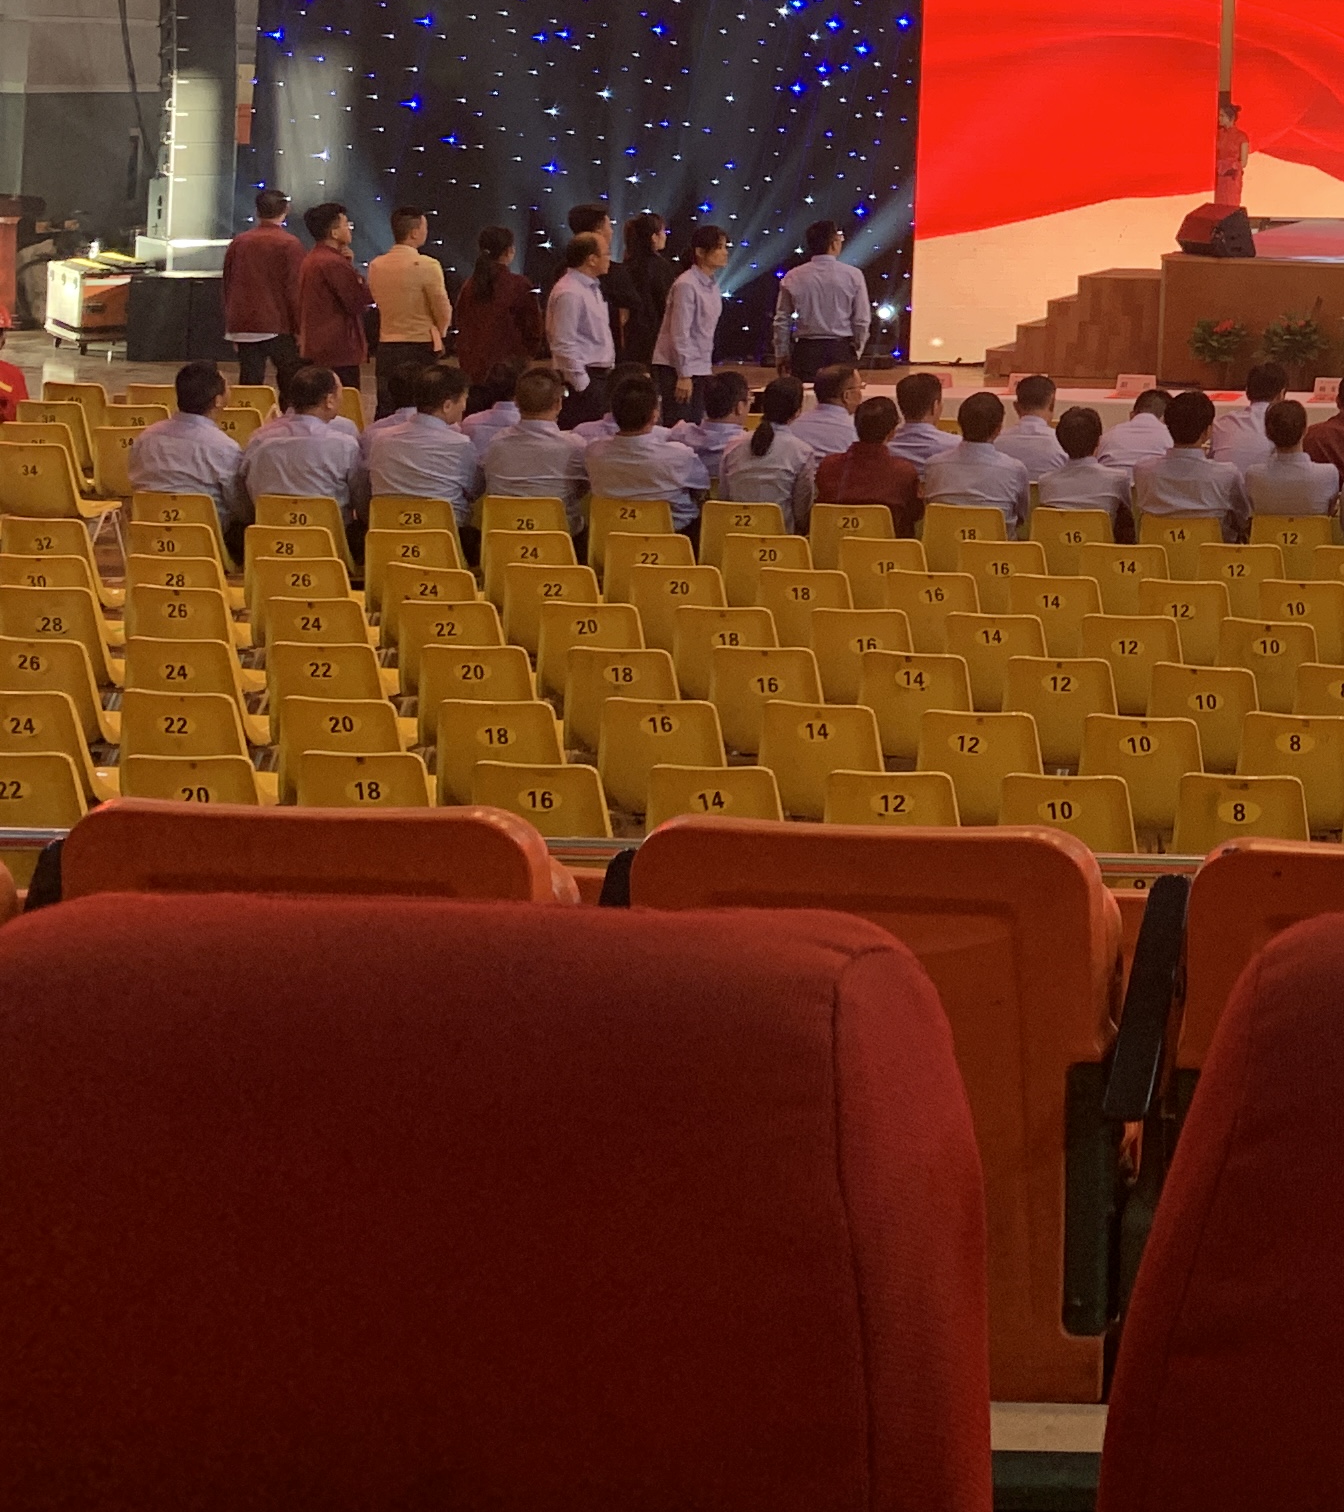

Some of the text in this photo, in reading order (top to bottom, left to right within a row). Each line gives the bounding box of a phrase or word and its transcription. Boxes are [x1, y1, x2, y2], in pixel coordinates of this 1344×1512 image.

[22, 465, 38, 475] 34
[404, 513, 422, 524] 28
[735, 515, 751, 527] 22
[960, 529, 976, 540] 18
[35, 537, 54, 551] 32
[157, 540, 175, 553] 30
[275, 541, 294, 555] 28
[992, 563, 1009, 575] 16
[165, 573, 185, 587] 28
[543, 583, 563, 597] 22
[670, 581, 689, 595] 20
[792, 587, 810, 600] 18
[925, 587, 944, 602] 16
[1043, 595, 1060, 608] 14
[1287, 602, 1305, 616] 10
[167, 604, 187, 618] 26
[1172, 604, 1189, 618] 12
[41, 617, 63, 632] 28
[301, 617, 322, 631] 24
[435, 622, 457, 637] 22
[576, 619, 598, 635] 20
[982, 630, 1002, 644] 14
[1119, 640, 1138, 655] 12
[1260, 640, 1279, 654] 10
[18, 654, 40, 671] 26
[309, 662, 332, 678] 22
[165, 664, 188, 680] 24
[461, 665, 485, 680] 20
[611, 667, 633, 682] 18
[904, 671, 925, 687] 14
[757, 677, 778, 693] 16
[1050, 676, 1071, 692] 12
[1196, 694, 1216, 710] 10
[10, 718, 35, 734] 24
[164, 717, 188, 734] 22
[329, 716, 354, 733] 20
[648, 716, 673, 733] 16
[805, 723, 829, 740] 14
[485, 728, 508, 744] 18
[958, 735, 979, 754] 12
[1127, 736, 1151, 754] 10
[355, 782, 380, 800] 18
[528, 791, 553, 809] 16
[698, 791, 725, 811] 14
[880, 795, 906, 812] 12
[1047, 801, 1072, 820] 10
[1233, 803, 1245, 822] 8
